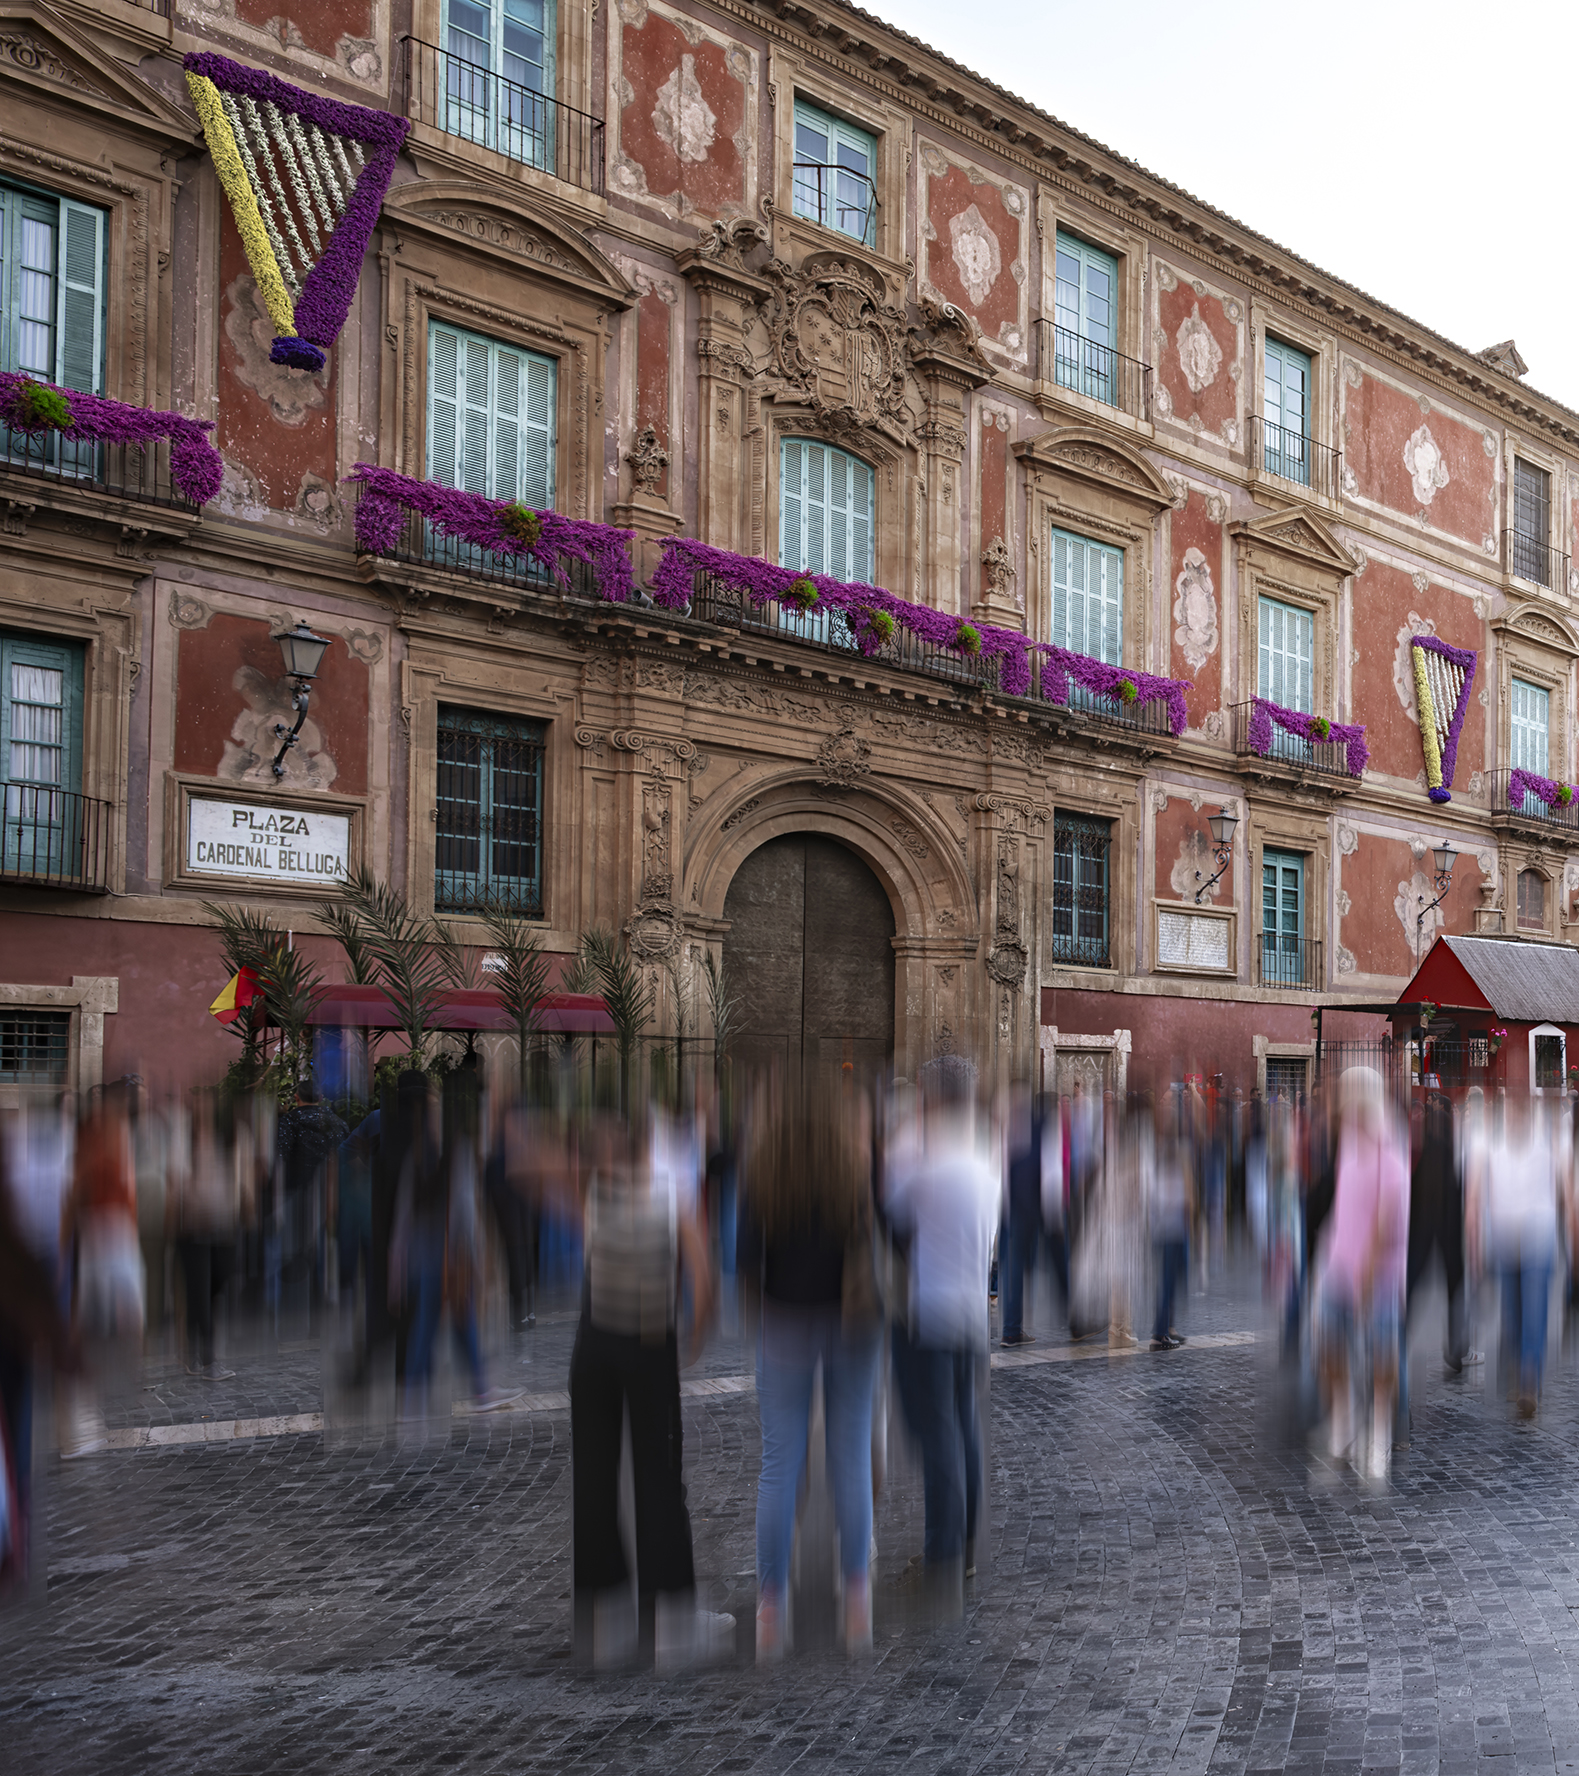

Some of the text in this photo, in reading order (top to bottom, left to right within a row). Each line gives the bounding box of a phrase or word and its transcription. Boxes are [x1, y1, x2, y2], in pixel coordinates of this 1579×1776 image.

[232, 809, 310, 836] PLAZA
[250, 832, 292, 847] DEL
[196, 841, 272, 869] CARDENAL
